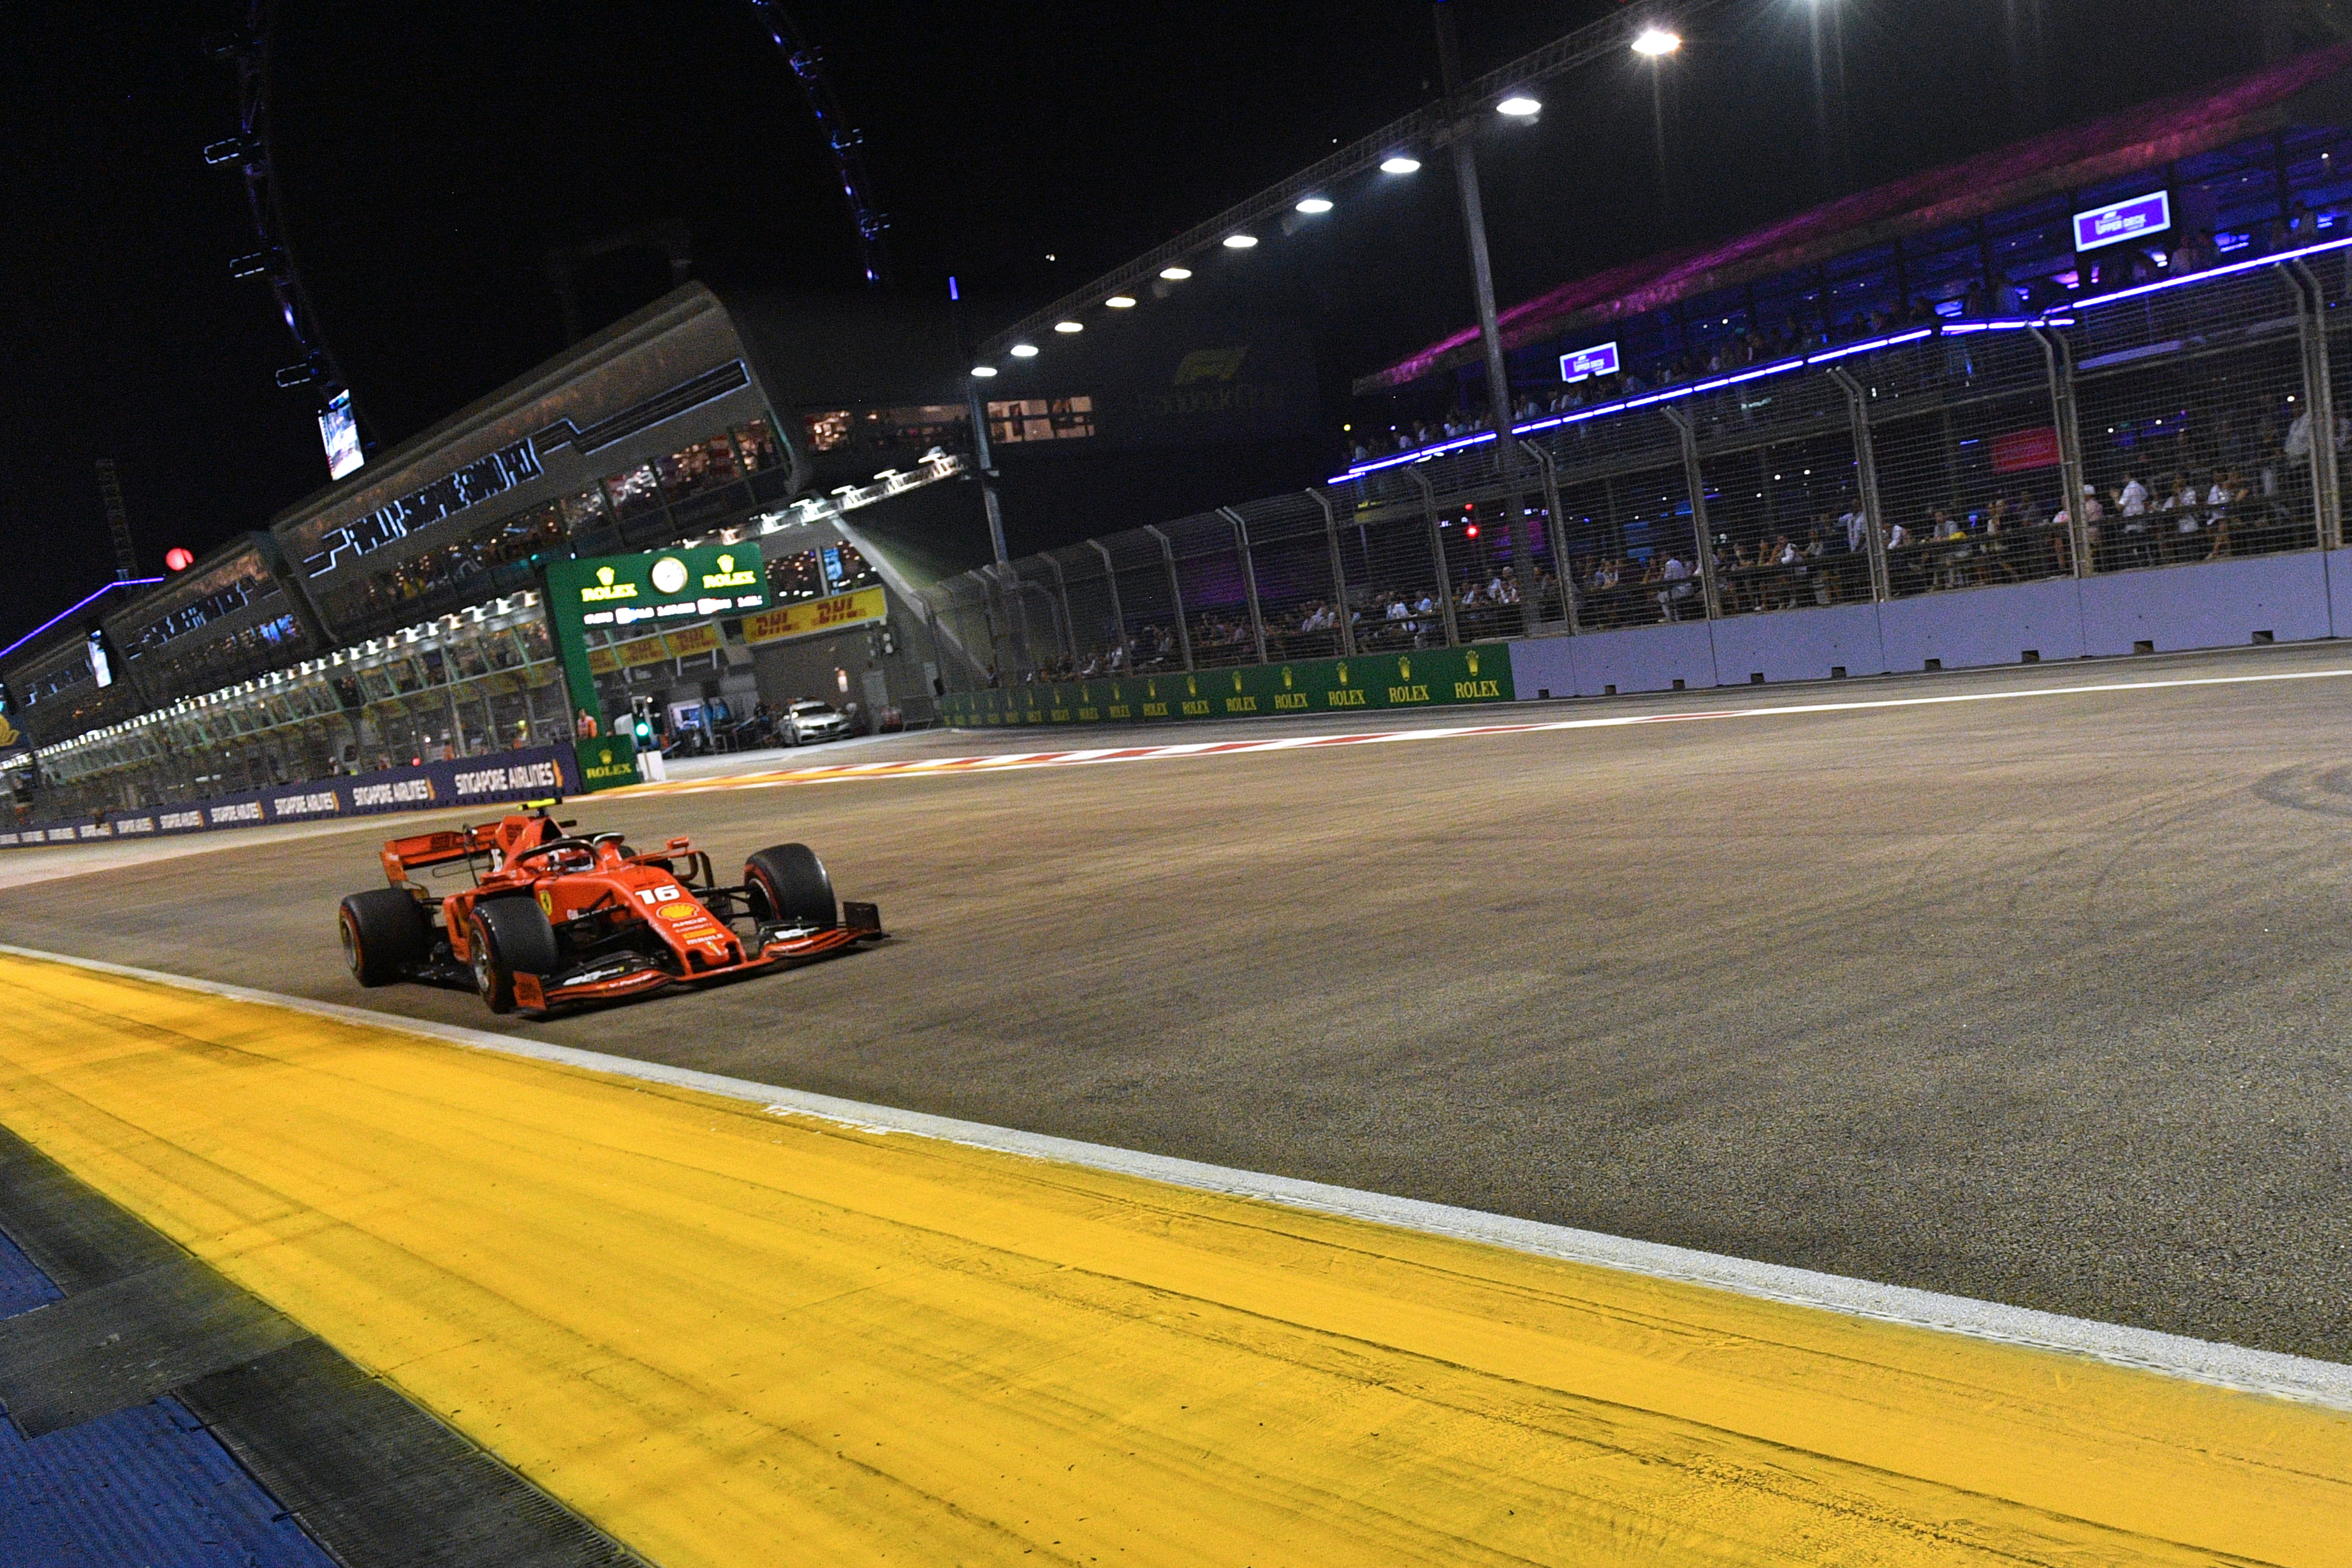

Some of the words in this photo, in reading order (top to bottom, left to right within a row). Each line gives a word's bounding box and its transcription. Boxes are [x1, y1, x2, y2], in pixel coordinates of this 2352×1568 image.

[703, 570, 757, 588] ROLEX
[581, 583, 638, 602] ROLEX
[1328, 689, 1366, 706] ROLEX
[1389, 685, 1430, 702] ROLEX
[1454, 680, 1500, 699] ROLEX
[1225, 696, 1257, 712] ROLEX
[1275, 693, 1308, 709] ROLEX
[454, 768, 508, 795] SINGAPORE
[508, 762, 555, 789] AIRLINES
[587, 763, 632, 779] ROLEX
[634, 885, 680, 905] 16
